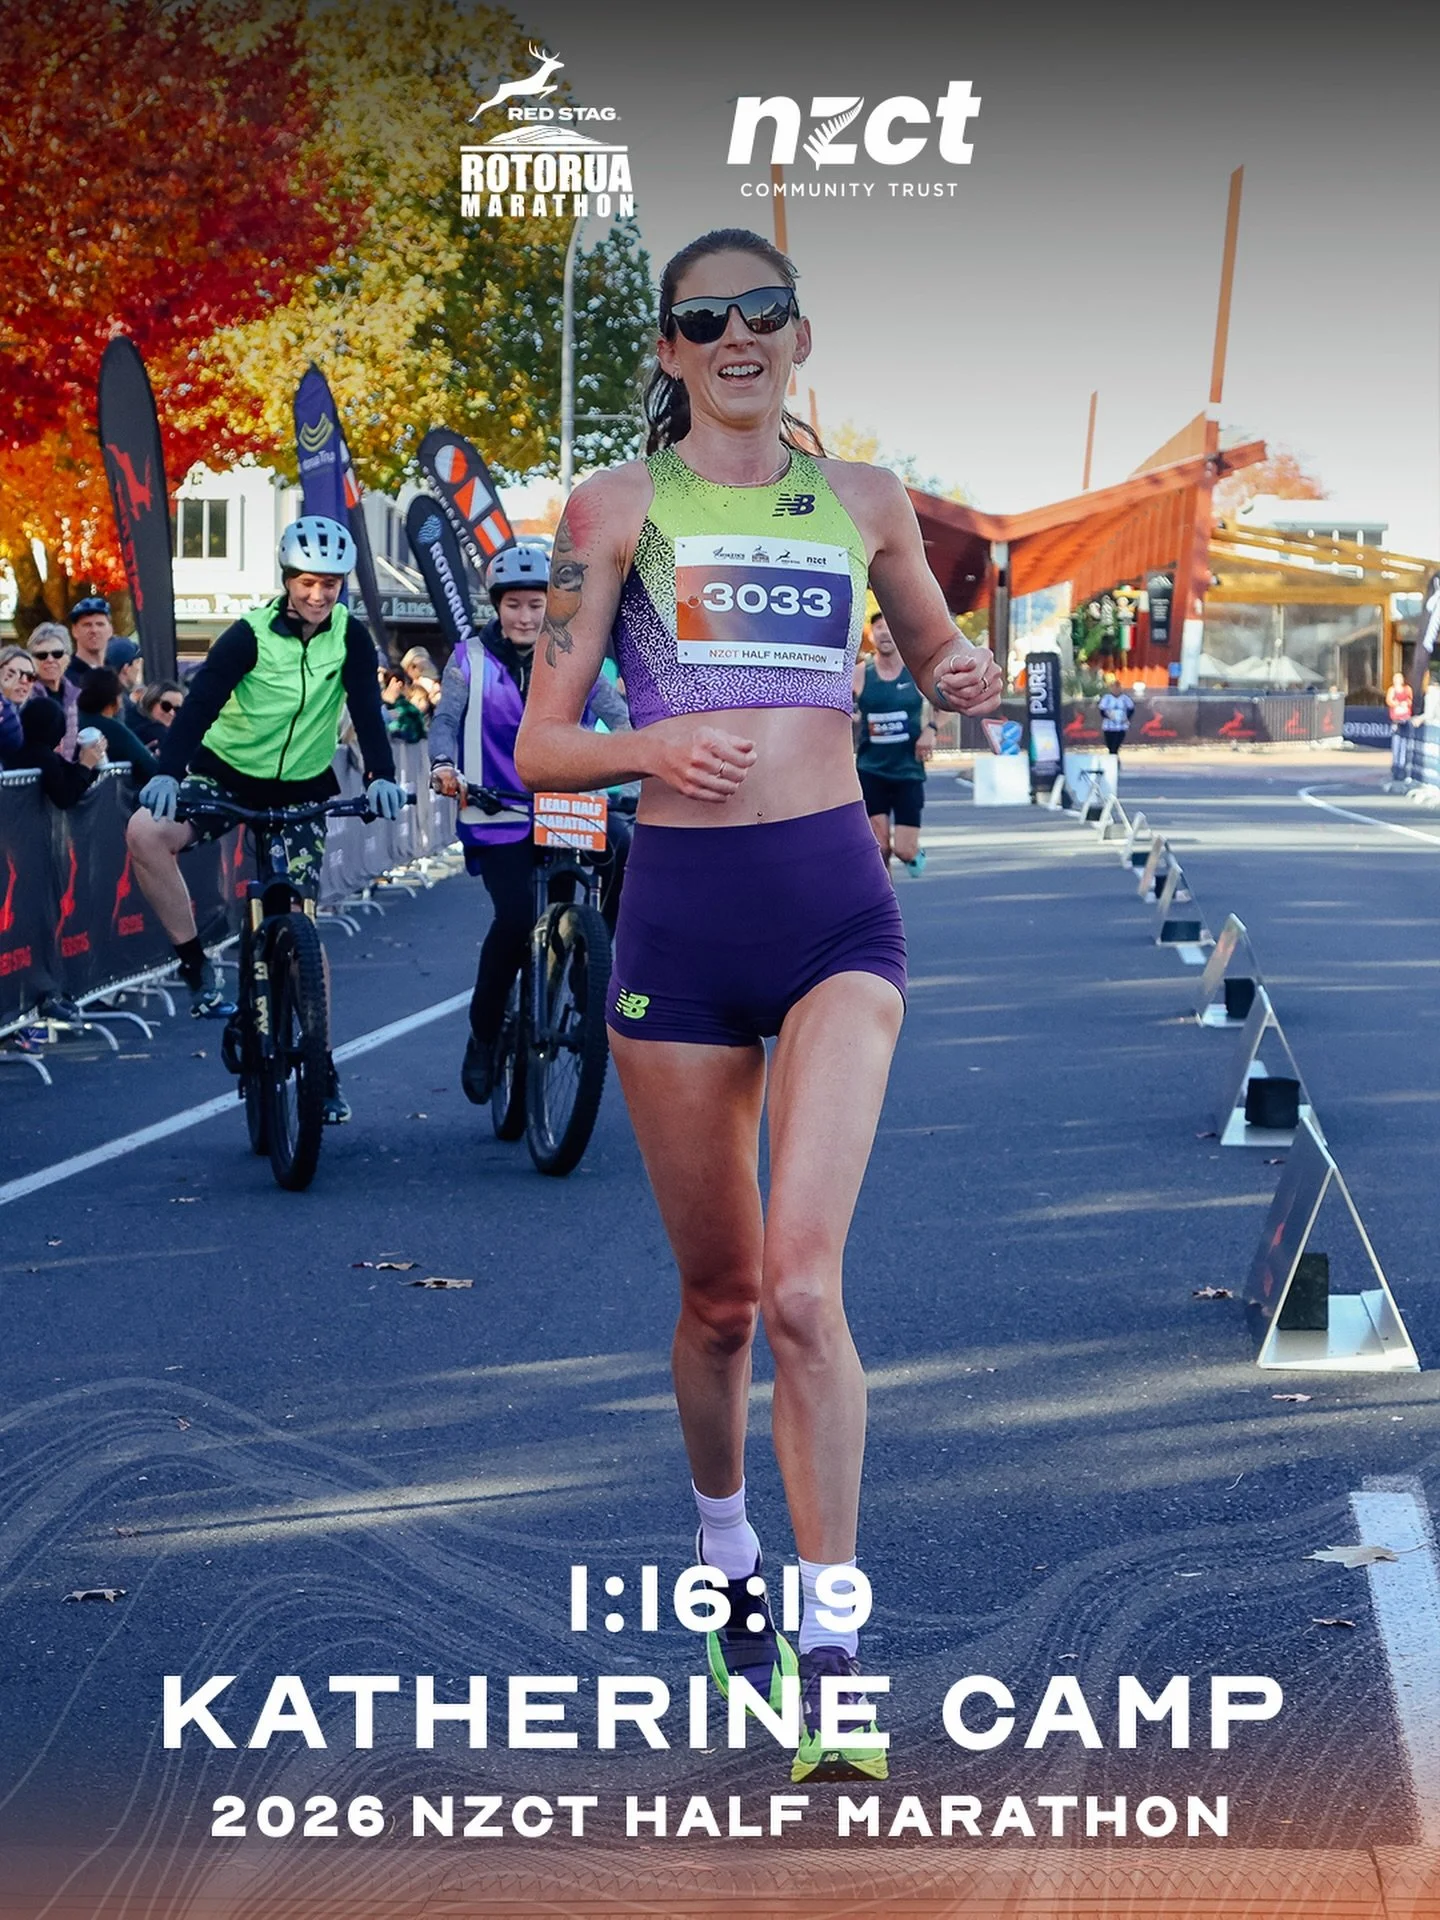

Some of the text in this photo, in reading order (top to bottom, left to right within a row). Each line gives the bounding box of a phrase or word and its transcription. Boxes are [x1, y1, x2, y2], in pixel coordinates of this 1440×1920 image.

[430, 541, 472, 640] ROTORUA
[702, 582, 832, 618] 3033
[709, 649, 827, 664] NZCT HALF MARATHON
[1028, 662, 1048, 714] PURE
[539, 797, 602, 816] LEAD HALF
